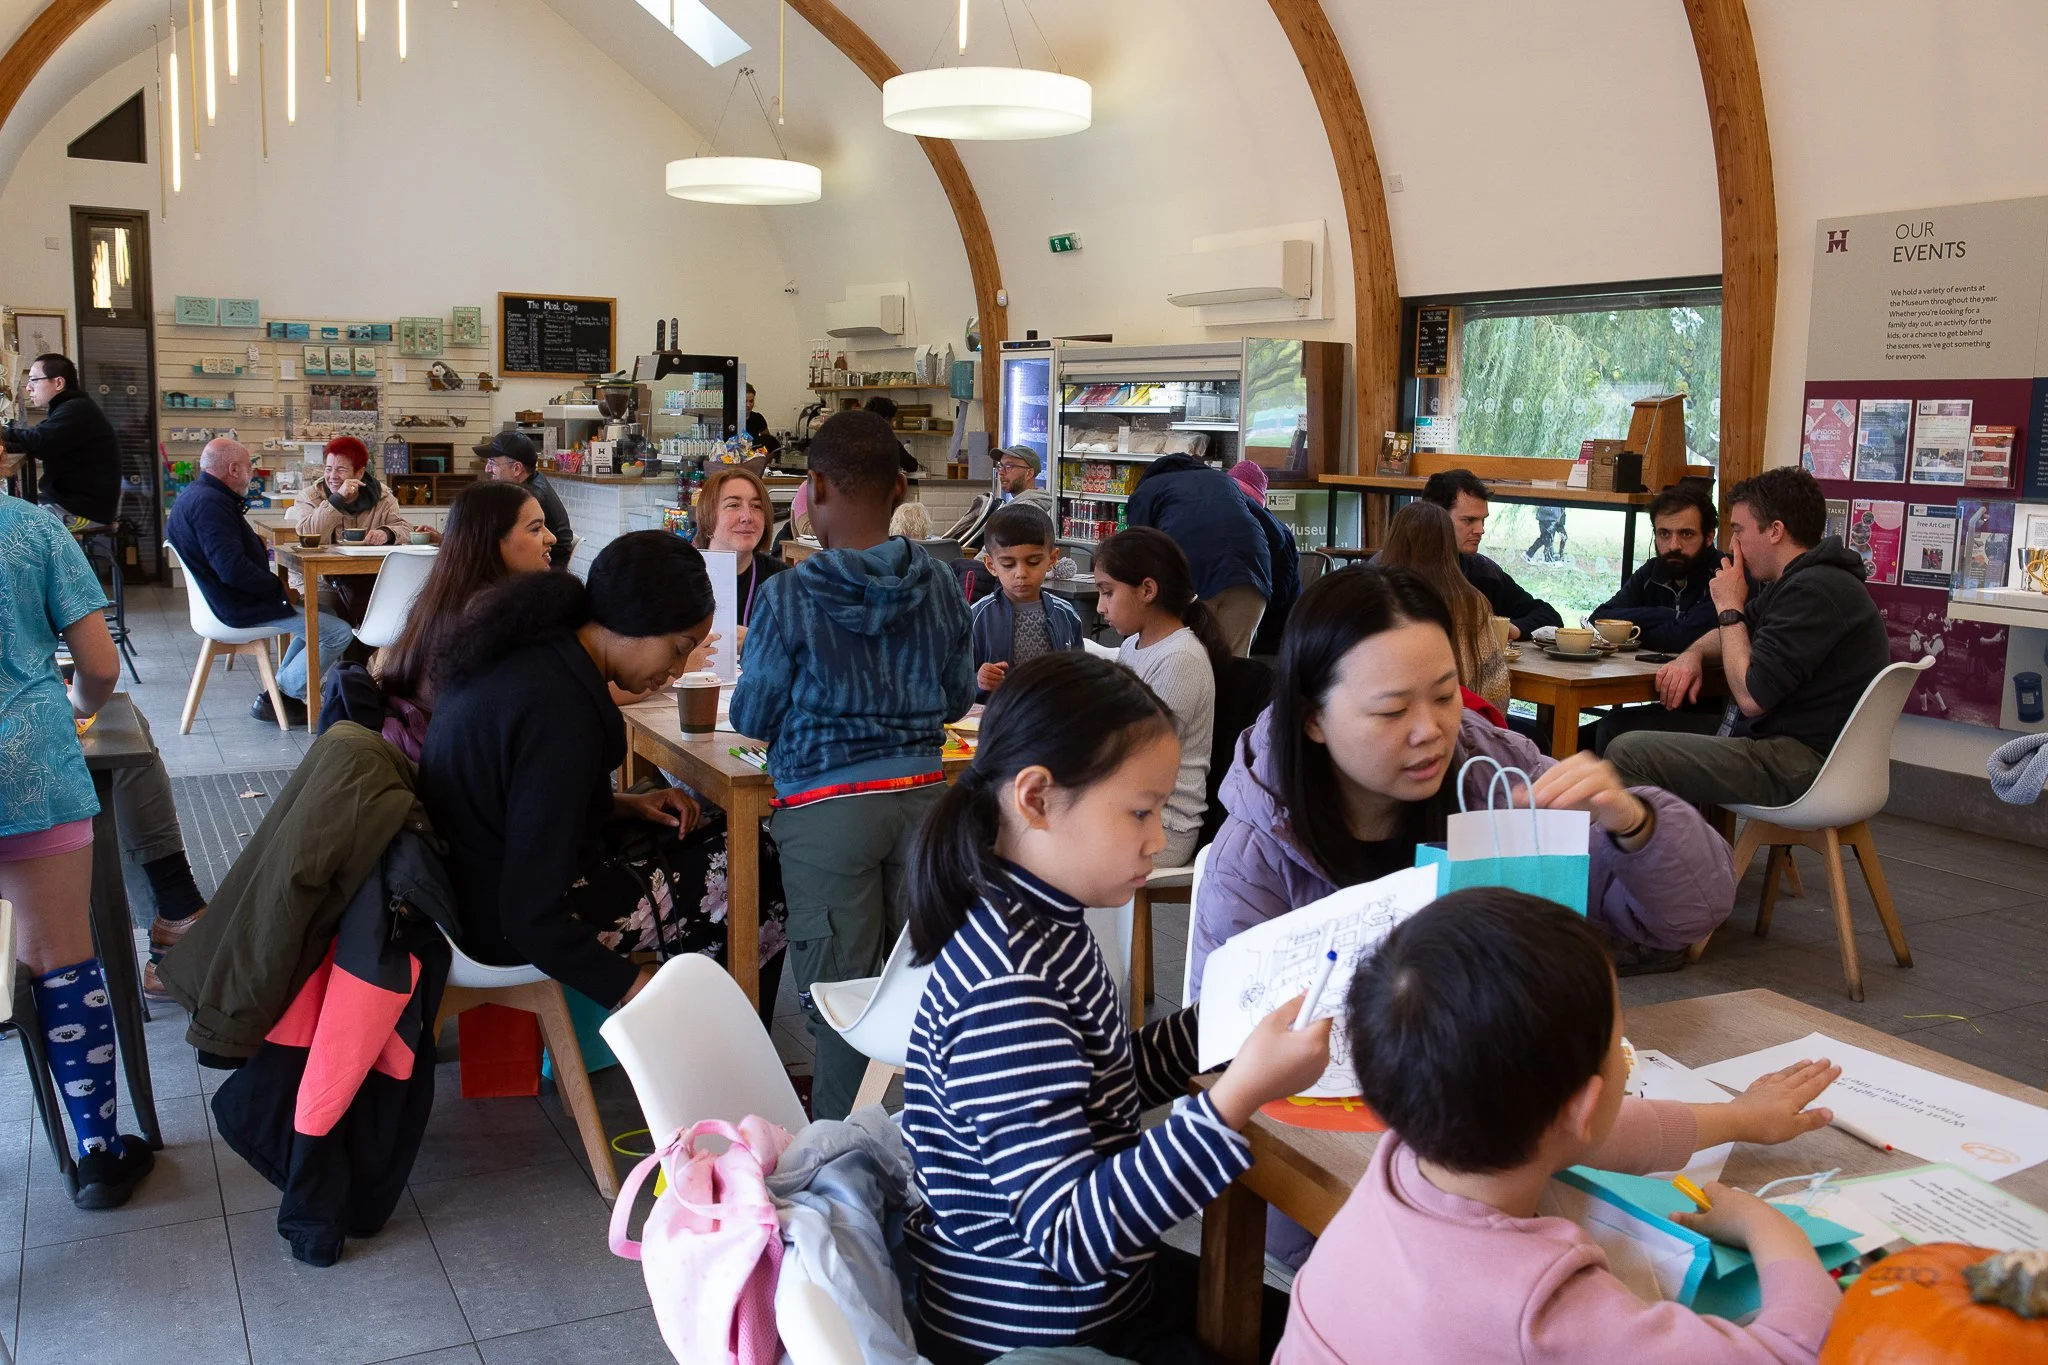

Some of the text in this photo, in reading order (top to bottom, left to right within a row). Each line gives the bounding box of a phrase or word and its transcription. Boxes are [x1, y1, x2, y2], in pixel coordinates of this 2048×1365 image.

[1896, 222, 1934, 239] OUR
[1893, 240, 1966, 263] EVENTS
[1923, 287, 1945, 295] variety
[526, 300, 540, 309] The
[1930, 296, 1968, 306] throughout
[1918, 309, 1938, 318] you're
[1939, 308, 1964, 316] looking
[1888, 321, 1907, 329] family
[1942, 342, 1954, 350] got
[1954, 340, 1990, 348] something
[1286, 522, 1338, 536] Museu
[1847, 1086, 1878, 1098] light
[1873, 1087, 1907, 1099] your
[1881, 1096, 1924, 1113] brings
[1927, 1104, 1965, 1118] hope
[1926, 1112, 1965, 1128] What
